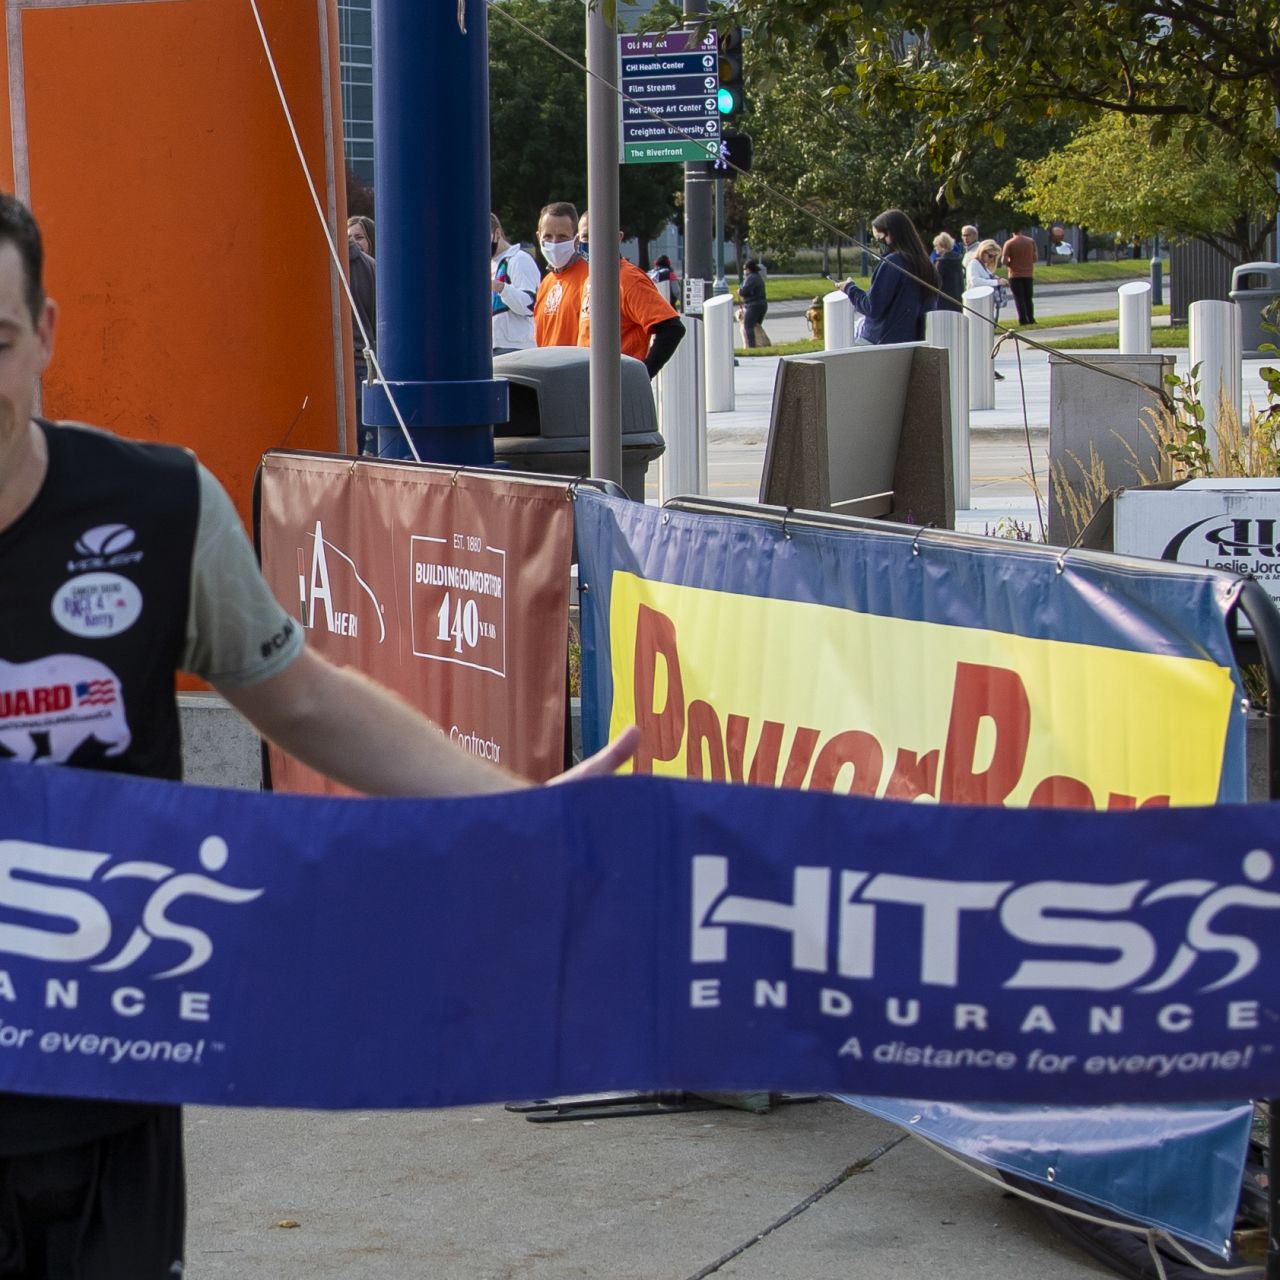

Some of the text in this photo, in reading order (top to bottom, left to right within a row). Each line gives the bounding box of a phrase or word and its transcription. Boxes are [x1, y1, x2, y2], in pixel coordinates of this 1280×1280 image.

[626, 61, 685, 72] CHI Health Center
[628, 83, 676, 92] Film Streams
[629, 106, 641, 114] Hot
[666, 104, 677, 112] Art
[678, 104, 702, 112] Center
[630, 126, 665, 138] Creighton
[631, 147, 683, 158] The Riverfront
[415, 562, 460, 588] BUILDING
[436, 592, 479, 653] 140
[691, 854, 1157, 991] HITS
[690, 978, 1259, 1034] ENDURANCE
[838, 1036, 863, 1060] A
[873, 1039, 1017, 1069] distance
[1026, 1049, 1076, 1073] for
